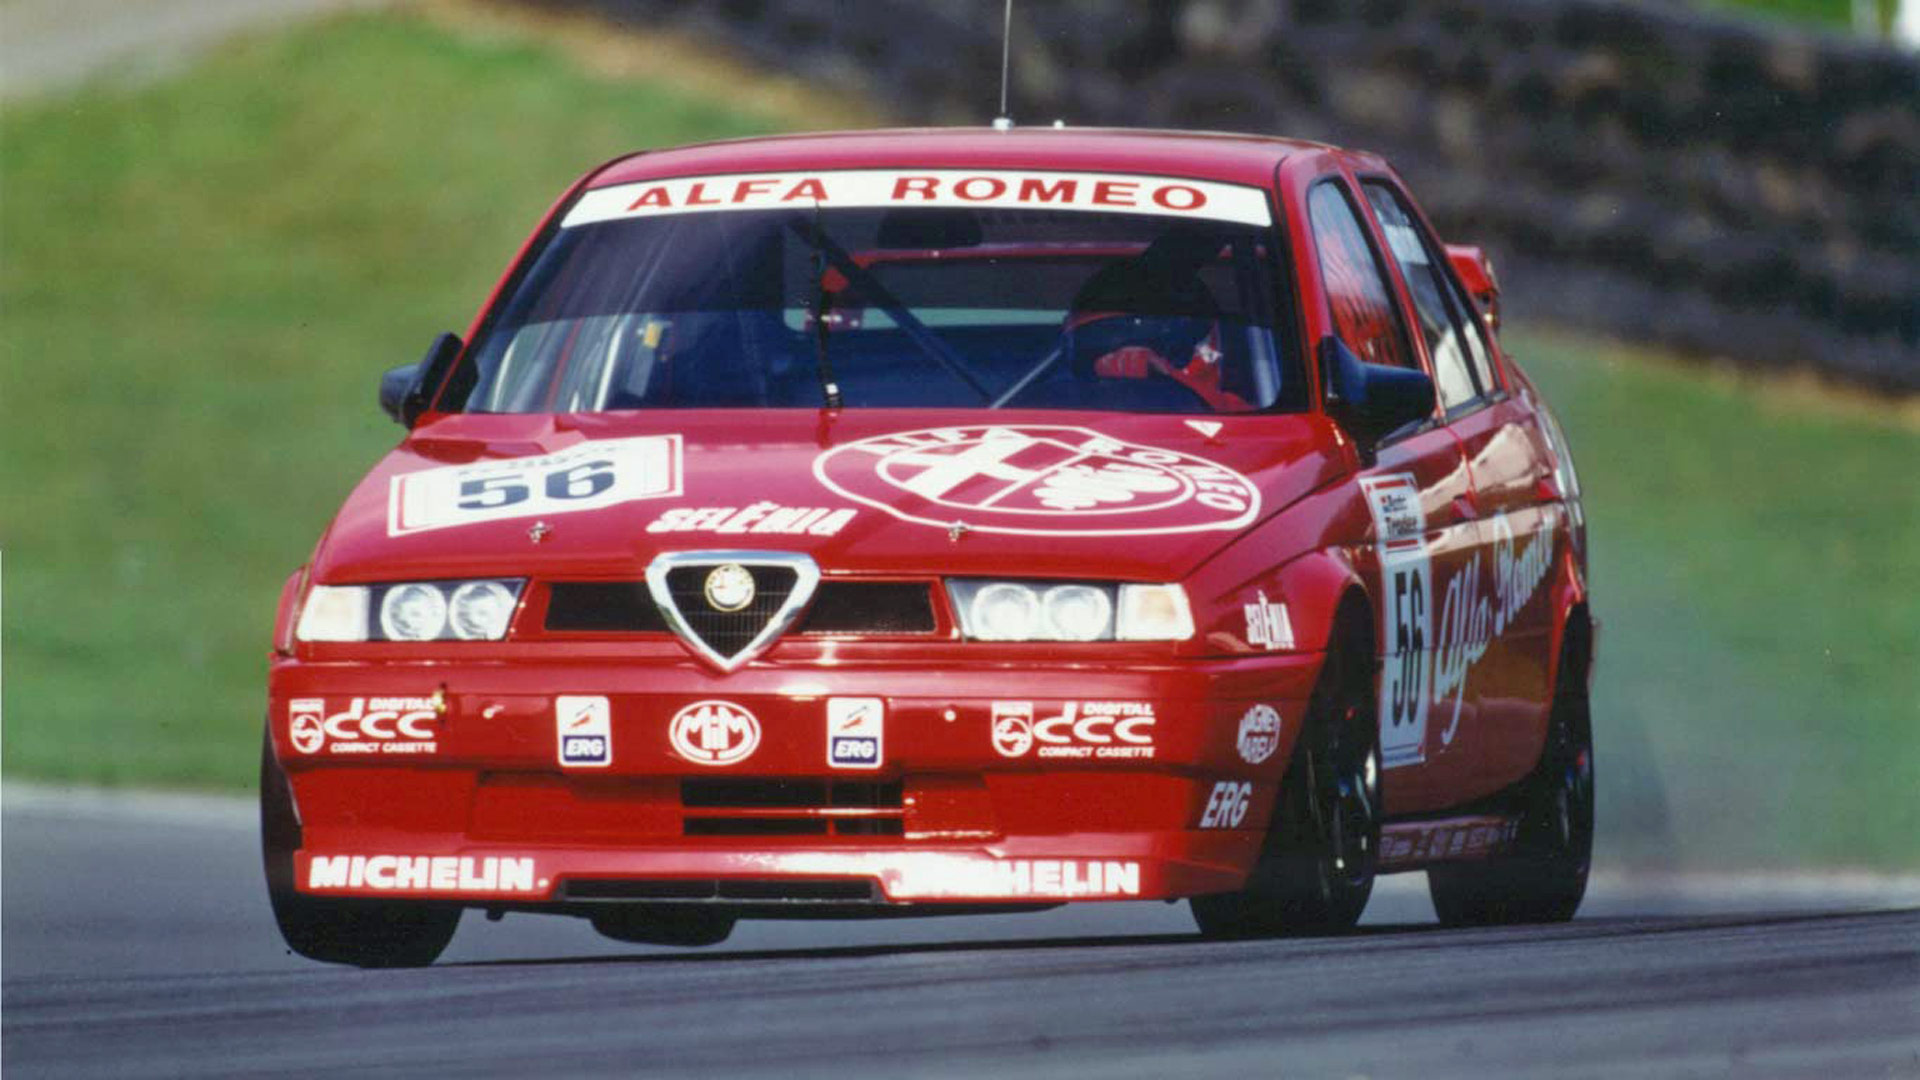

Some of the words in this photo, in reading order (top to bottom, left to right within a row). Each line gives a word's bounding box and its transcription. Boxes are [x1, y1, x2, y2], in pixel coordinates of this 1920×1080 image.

[626, 178, 829, 212] ALFA
[892, 176, 1208, 210] ROMEO
[457, 459, 616, 510] 56
[1080, 435, 1248, 512] ROMEO
[1392, 568, 1424, 727] 56
[1082, 702, 1155, 716] DIGITAL
[330, 743, 380, 753] COMPACT
[382, 743, 437, 753] CASSETTE
[564, 738, 605, 755] ERG
[834, 739, 876, 759] ERG
[1038, 746, 1093, 757] COMPACT
[1095, 747, 1155, 758] CASSETTE
[1200, 782, 1252, 828] ERG
[308, 856, 536, 891] MICHELIN
